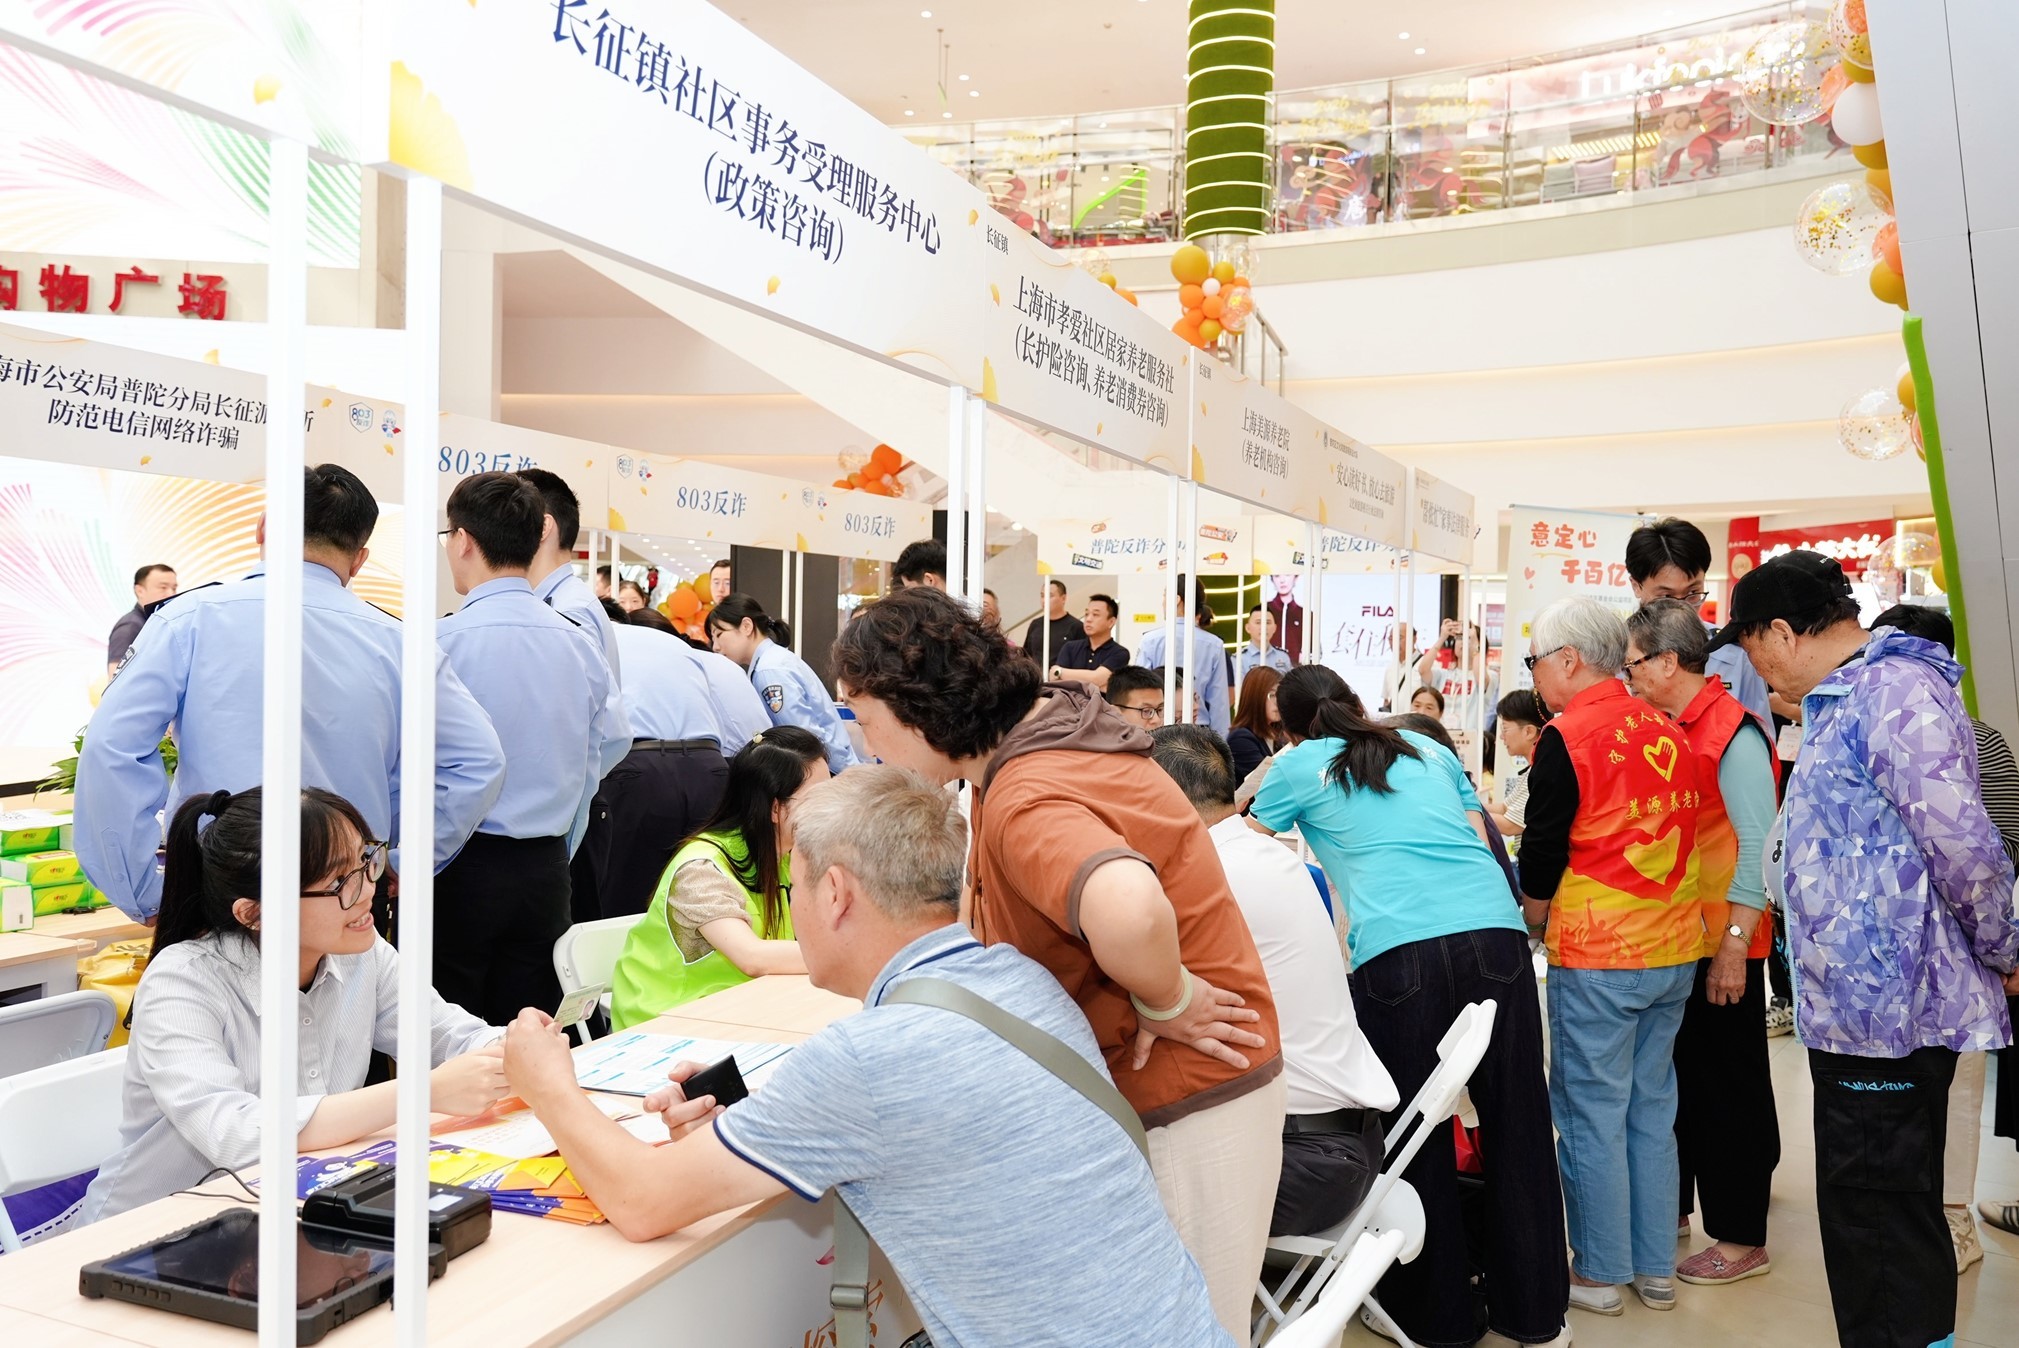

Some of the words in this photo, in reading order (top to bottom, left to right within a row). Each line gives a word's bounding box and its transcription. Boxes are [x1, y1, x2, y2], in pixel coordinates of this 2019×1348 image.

[550, 0, 942, 255] 长征镇社区事务受理服务中心
[704, 150, 844, 265] (政策咨询)
[986, 224, 1009, 256] 长征镇
[1013, 275, 1175, 394] 上海市孝爱社区居家养老服务社
[47, 398, 240, 451] 防范电信网络诈骗
[676, 486, 748, 518] 803反诈
[843, 512, 897, 539] 803反诈
[1530, 521, 1597, 550] 意定心
[1361, 605, 1394, 617] FILA
